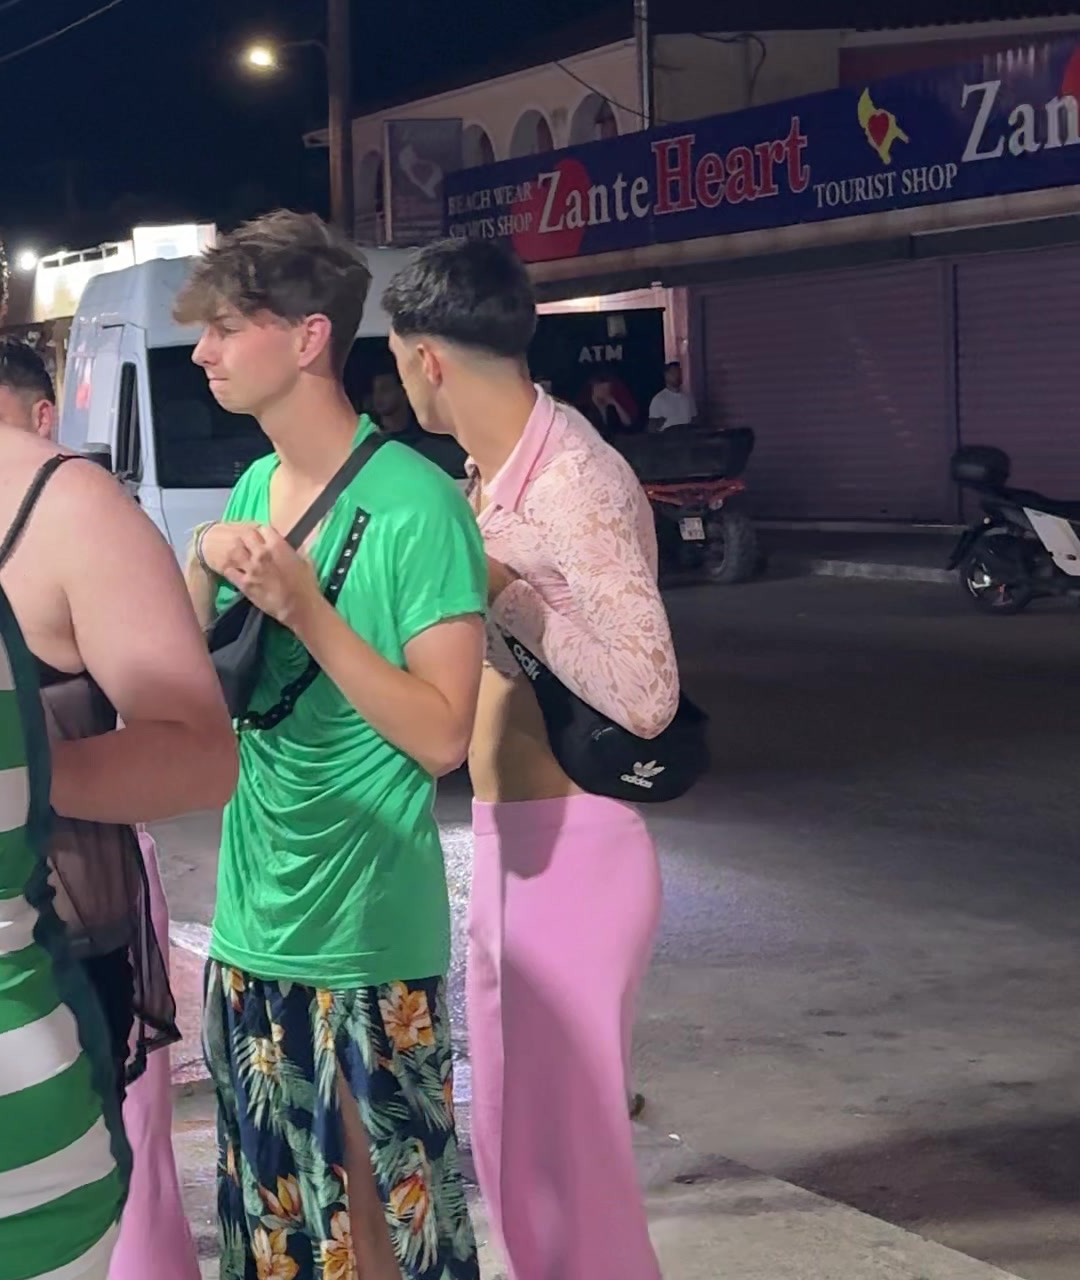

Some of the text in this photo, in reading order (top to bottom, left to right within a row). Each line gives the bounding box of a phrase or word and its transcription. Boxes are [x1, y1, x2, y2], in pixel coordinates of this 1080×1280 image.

[961, 80, 1080, 163] Zan
[448, 181, 533, 216] BEACH WEAR
[813, 162, 958, 208] TOURIST SHOP
[497, 211, 533, 237] SHOP
[578, 344, 623, 362] ATM
[620, 773, 654, 789] adidas
